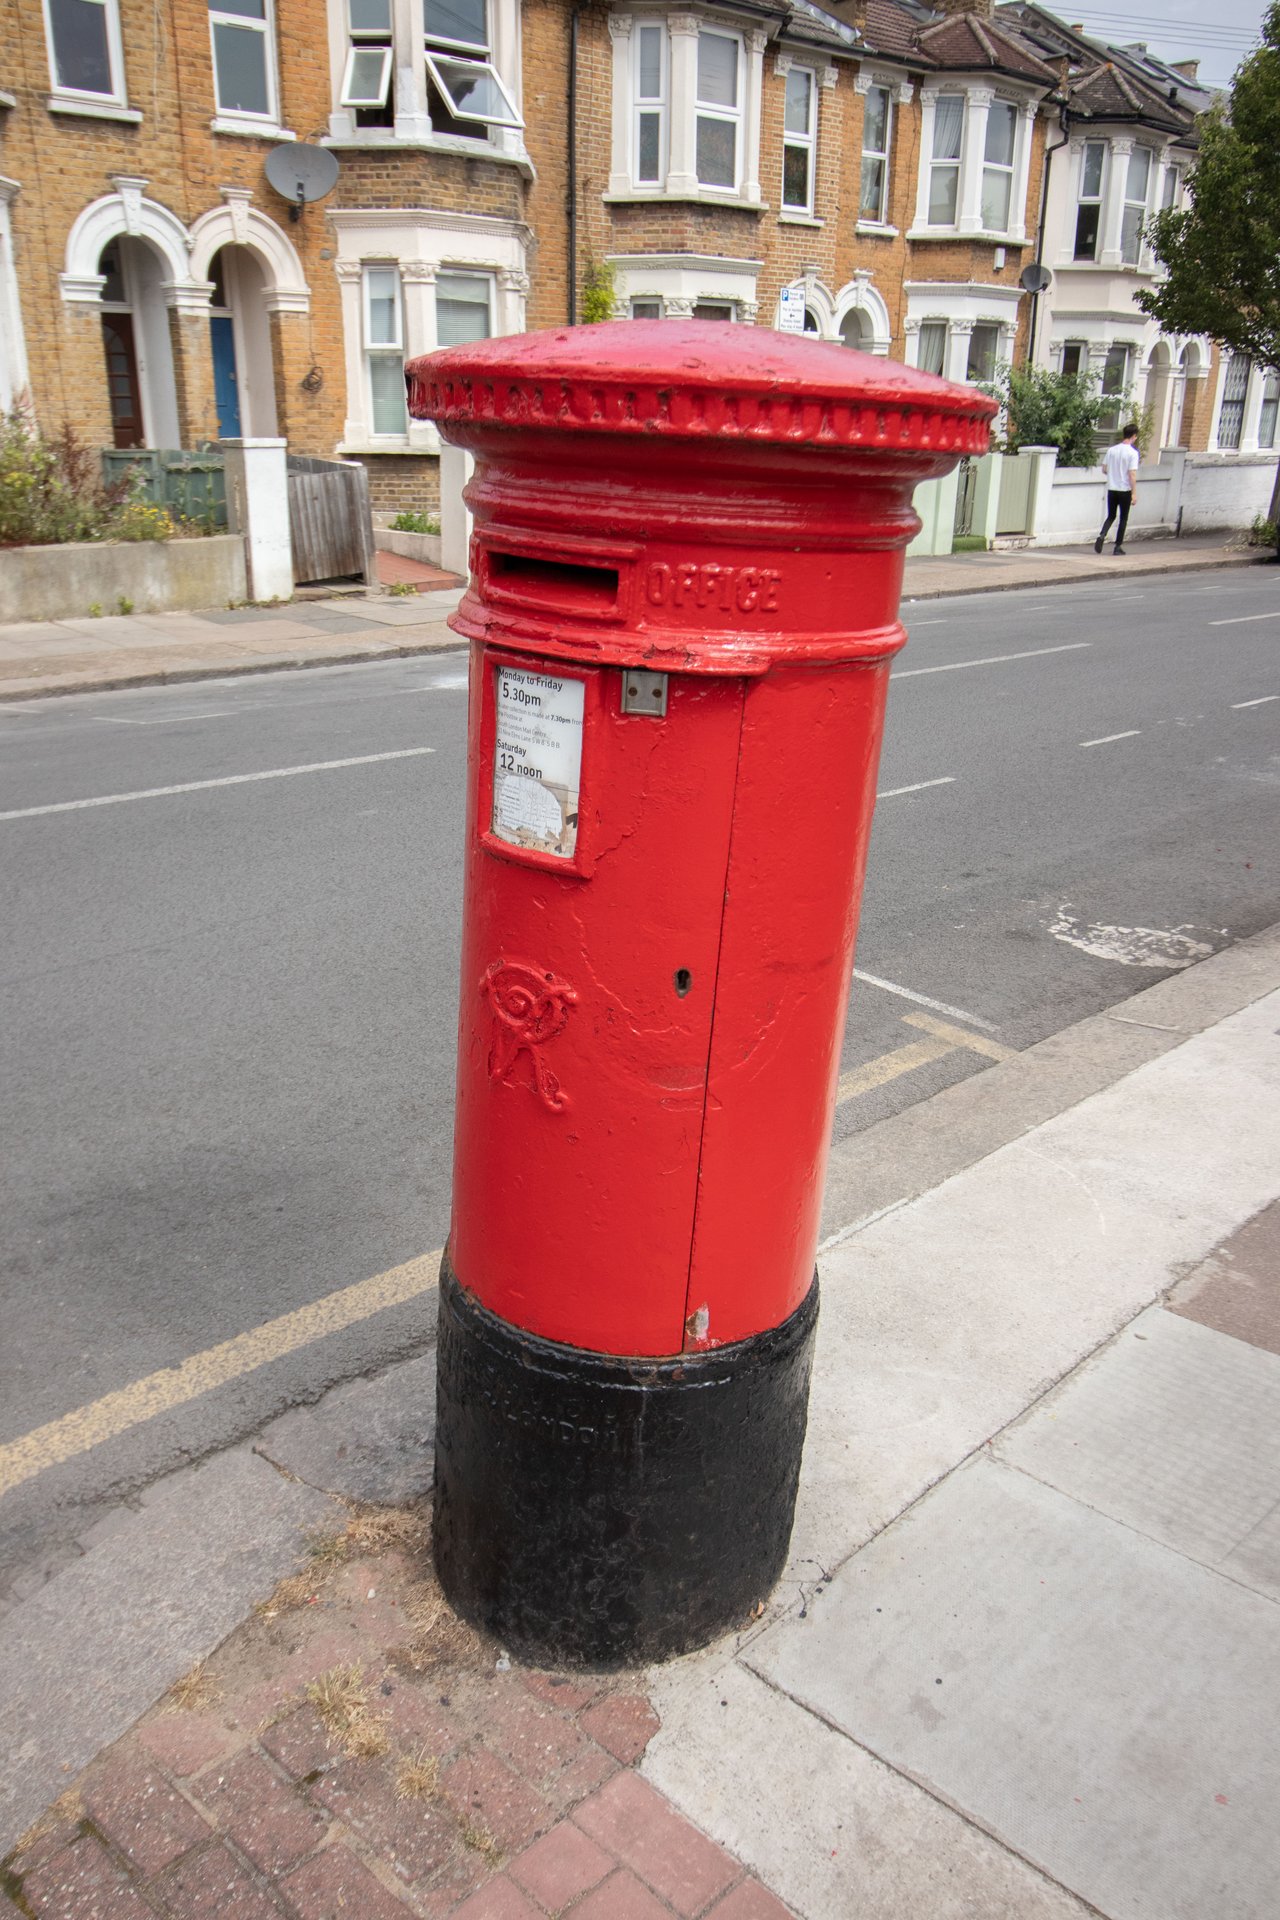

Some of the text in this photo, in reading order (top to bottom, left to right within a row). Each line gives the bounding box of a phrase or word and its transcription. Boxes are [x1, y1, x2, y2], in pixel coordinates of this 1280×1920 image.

[649, 562, 781, 613] OFFICE
[498, 668, 563, 692] Monday to Friday
[503, 682, 541, 707] 5.30pm
[550, 714, 571, 724] 7.30pm
[497, 738, 527, 757] Saturday
[500, 753, 514, 771] 12
[517, 764, 543, 778] noon
